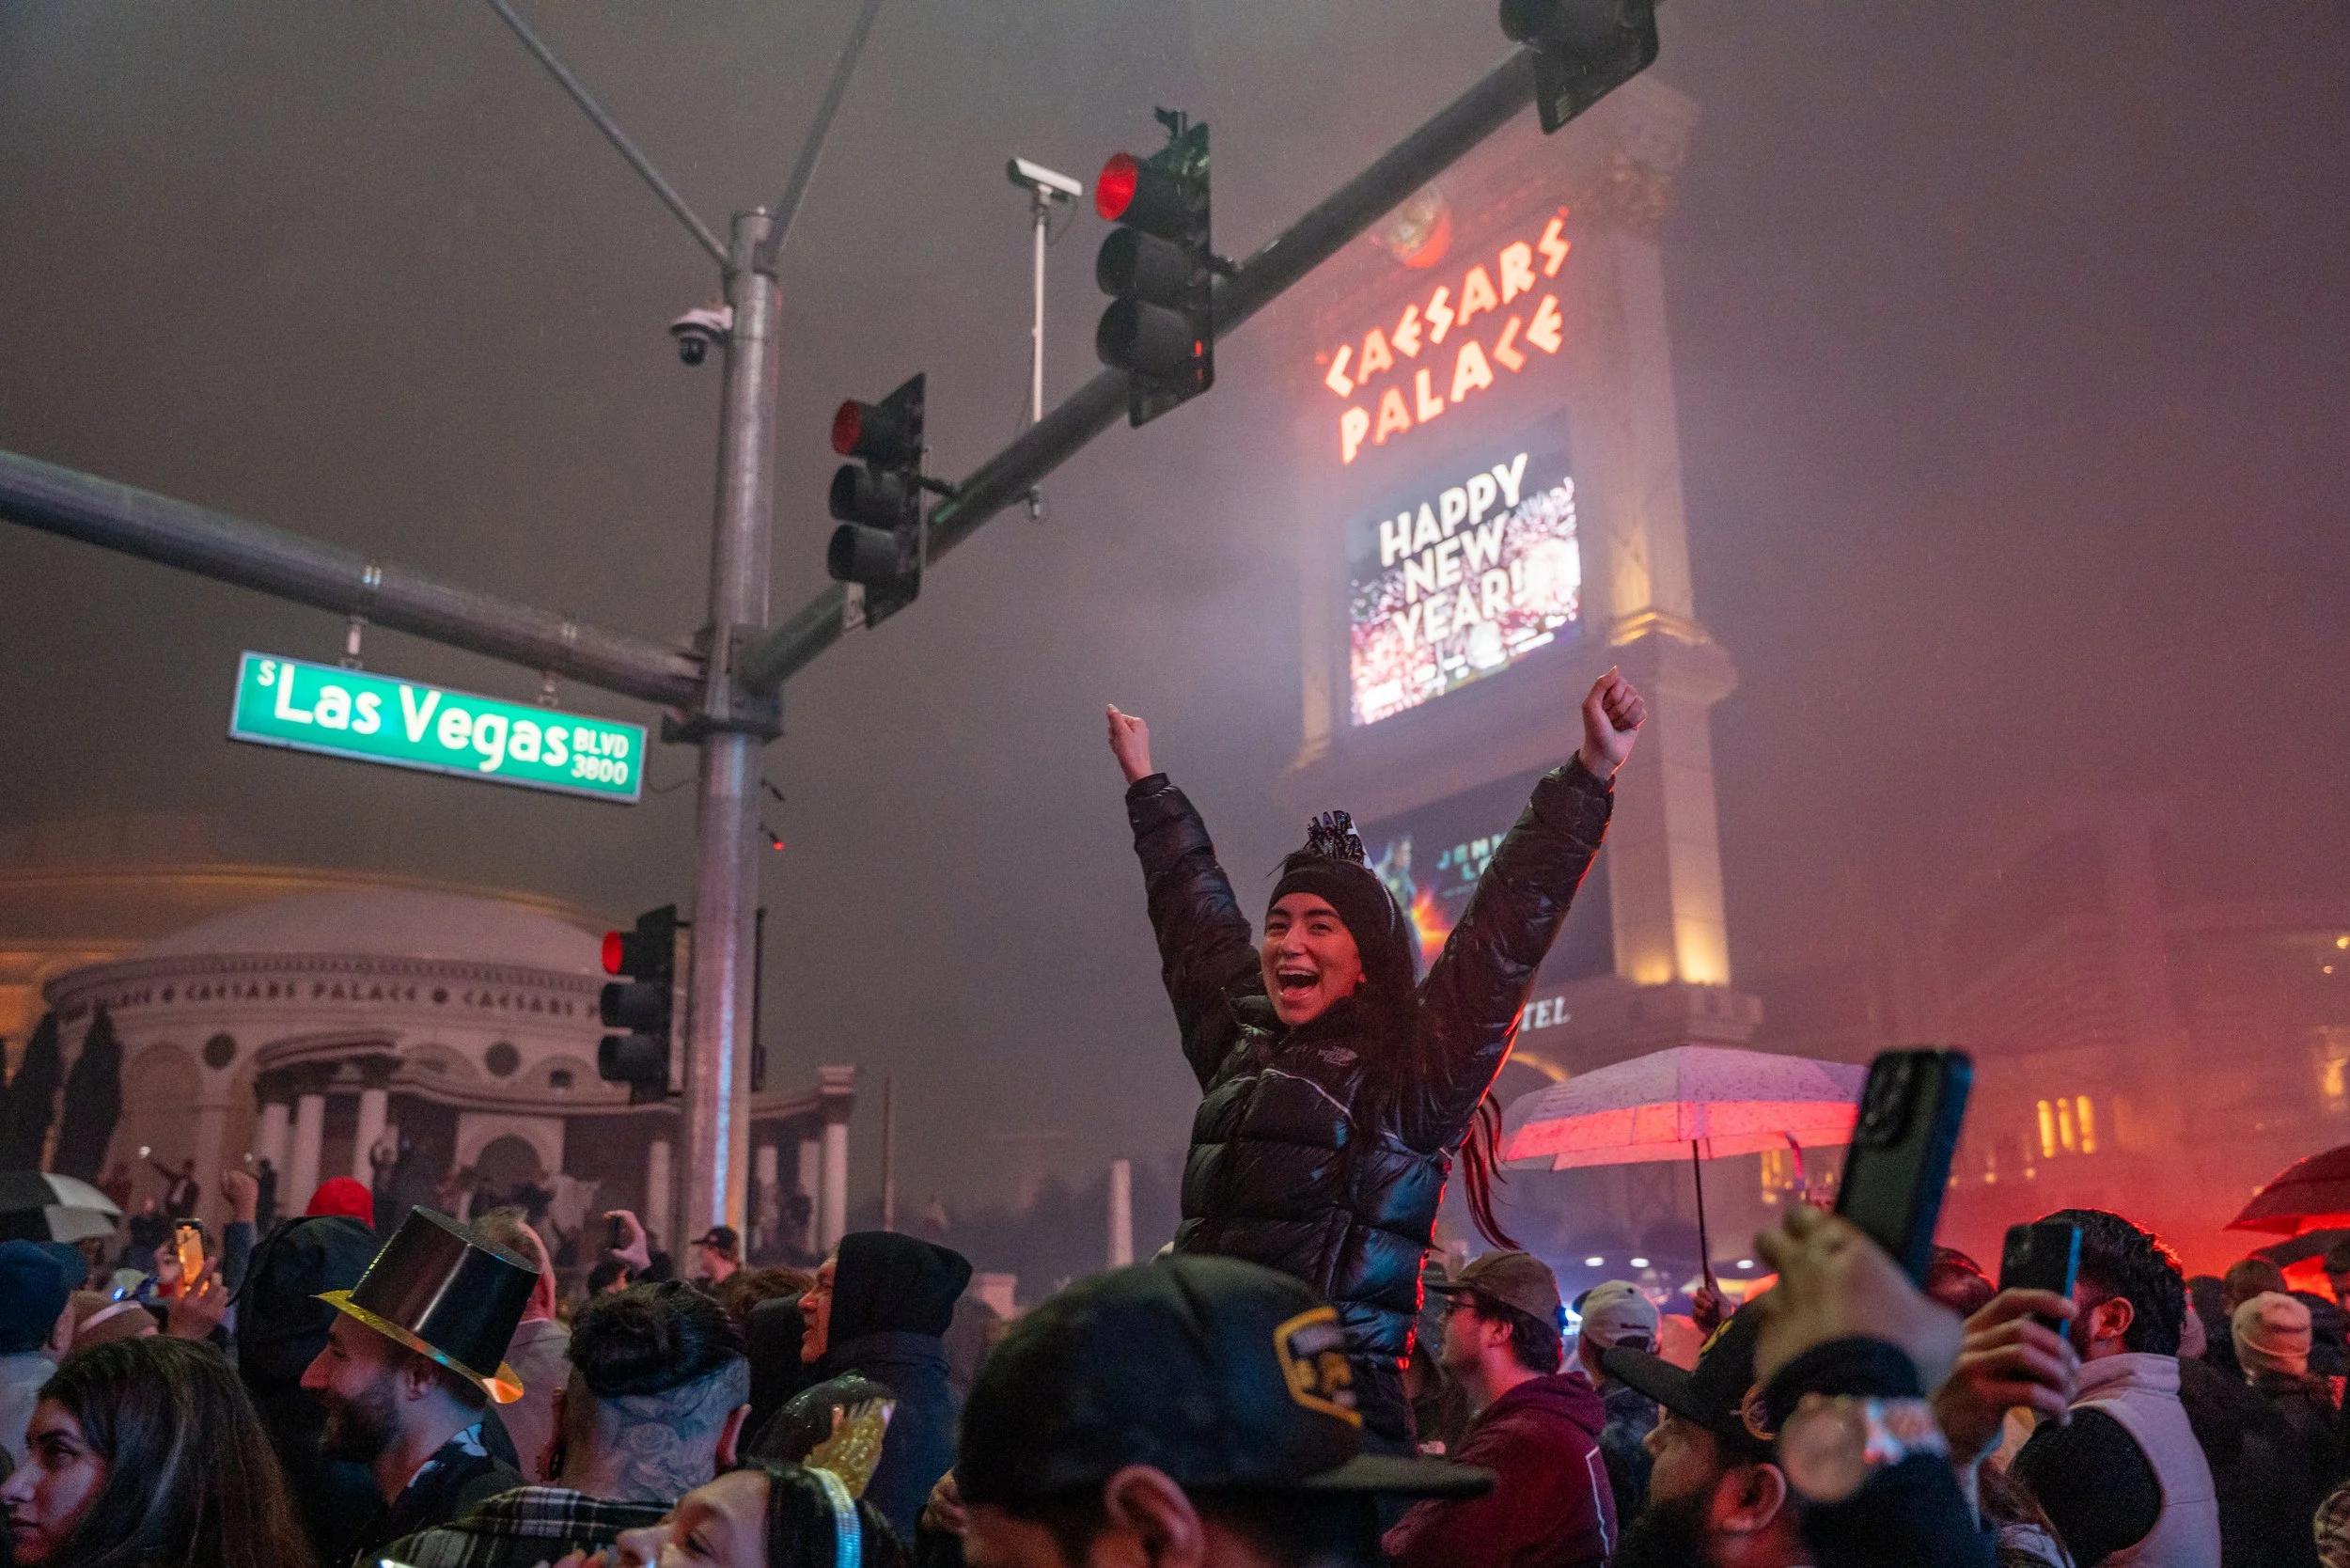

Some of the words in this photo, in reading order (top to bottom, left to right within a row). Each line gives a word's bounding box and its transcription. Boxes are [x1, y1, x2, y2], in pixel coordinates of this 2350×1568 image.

[1324, 216, 1572, 399] CAESARS
[1340, 292, 1563, 466] PALACE
[1379, 452, 1528, 567] HAPPY
[1403, 510, 1510, 604] NEW
[1391, 557, 1525, 652] YEAR!
[257, 659, 276, 687] S
[274, 663, 383, 735] Las
[399, 684, 571, 773] Vegas
[572, 726, 630, 760] BLVD
[570, 753, 630, 786] 3800
